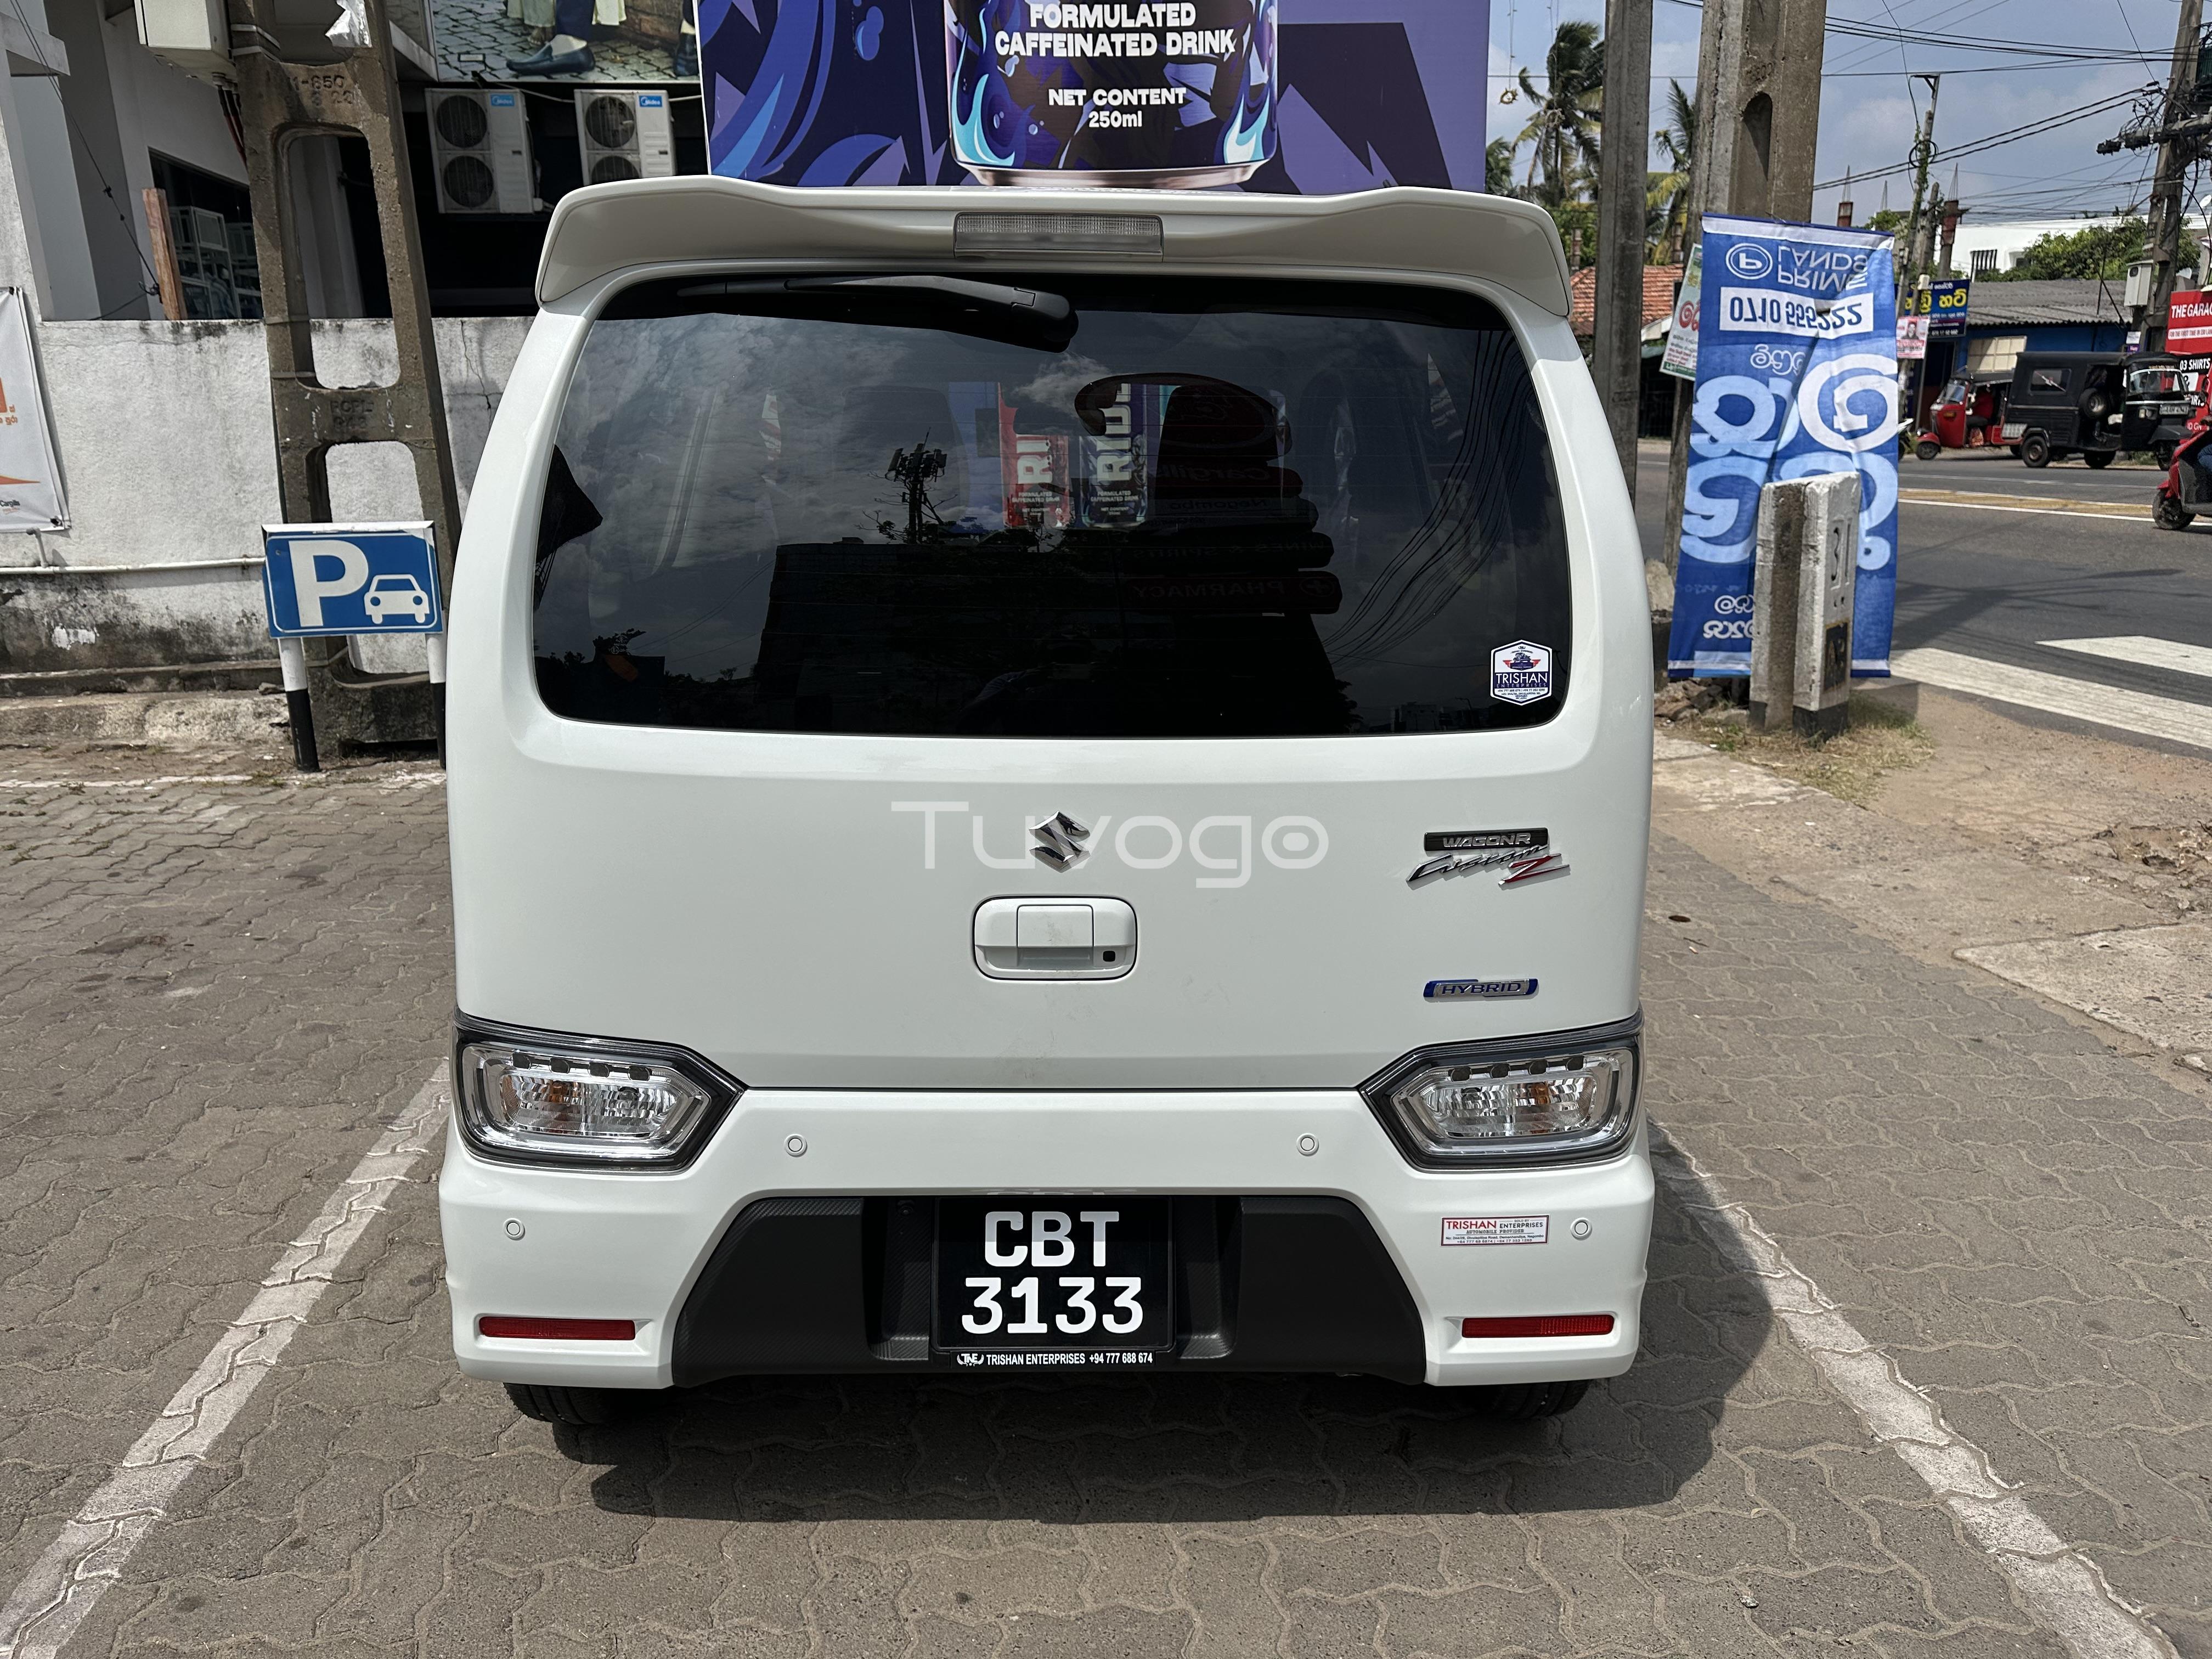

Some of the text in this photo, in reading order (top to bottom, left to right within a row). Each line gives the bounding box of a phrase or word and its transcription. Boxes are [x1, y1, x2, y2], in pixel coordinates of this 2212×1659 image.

[1030, 3, 1196, 28] FORMULATED
[995, 29, 1235, 57] CAFFEINATED DRINK
[1048, 87, 1186, 106] NET CONTENT
[1088, 110, 1142, 128] 250ml
[2171, 304, 2187, 318] THE
[2180, 360, 2187, 371] 03
[2188, 358, 2210, 370] SHIRTS
[289, 539, 369, 627] P
[1496, 673, 1548, 684] TRISHAN
[1442, 983, 1521, 995] HYBRID
[1446, 1220, 1497, 1229] TRISHAN
[985, 1211, 1119, 1267] CBT
[962, 1277, 1143, 1334] 3133
[986, 1355, 1024, 1365] TRISHAN
[1026, 1353, 1085, 1365] ENTERPRISES
[1089, 1353, 1104, 1364] +94
[1106, 1353, 1120, 1364] 777
[1122, 1353, 1136, 1364] 688
[1138, 1352, 1153, 1364] 674
